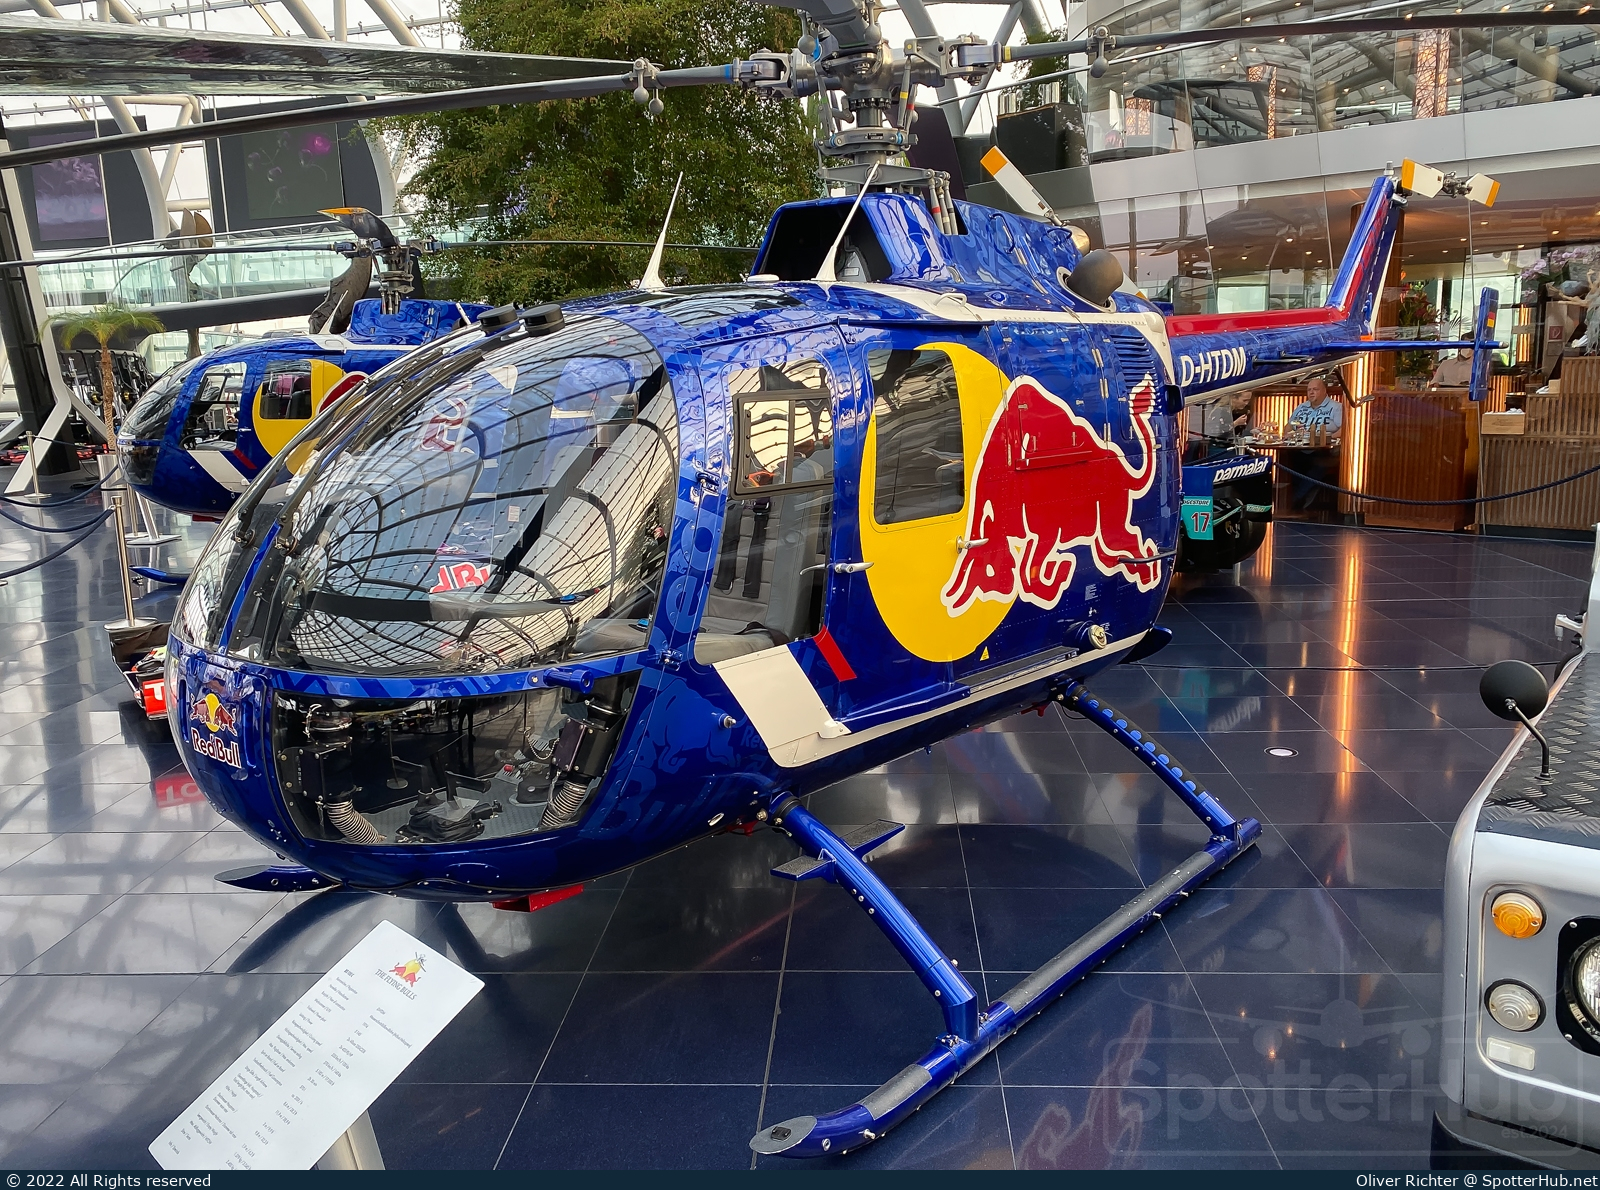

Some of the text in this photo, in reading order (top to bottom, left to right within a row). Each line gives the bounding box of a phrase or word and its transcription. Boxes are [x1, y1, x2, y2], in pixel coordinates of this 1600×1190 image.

[1180, 347, 1247, 387] D-HTDM
[1213, 458, 1269, 483] parmalat
[1191, 511, 1211, 533] 17
[191, 727, 242, 768] Red Bull
[374, 968, 418, 1001] THE FLYING BULLS
